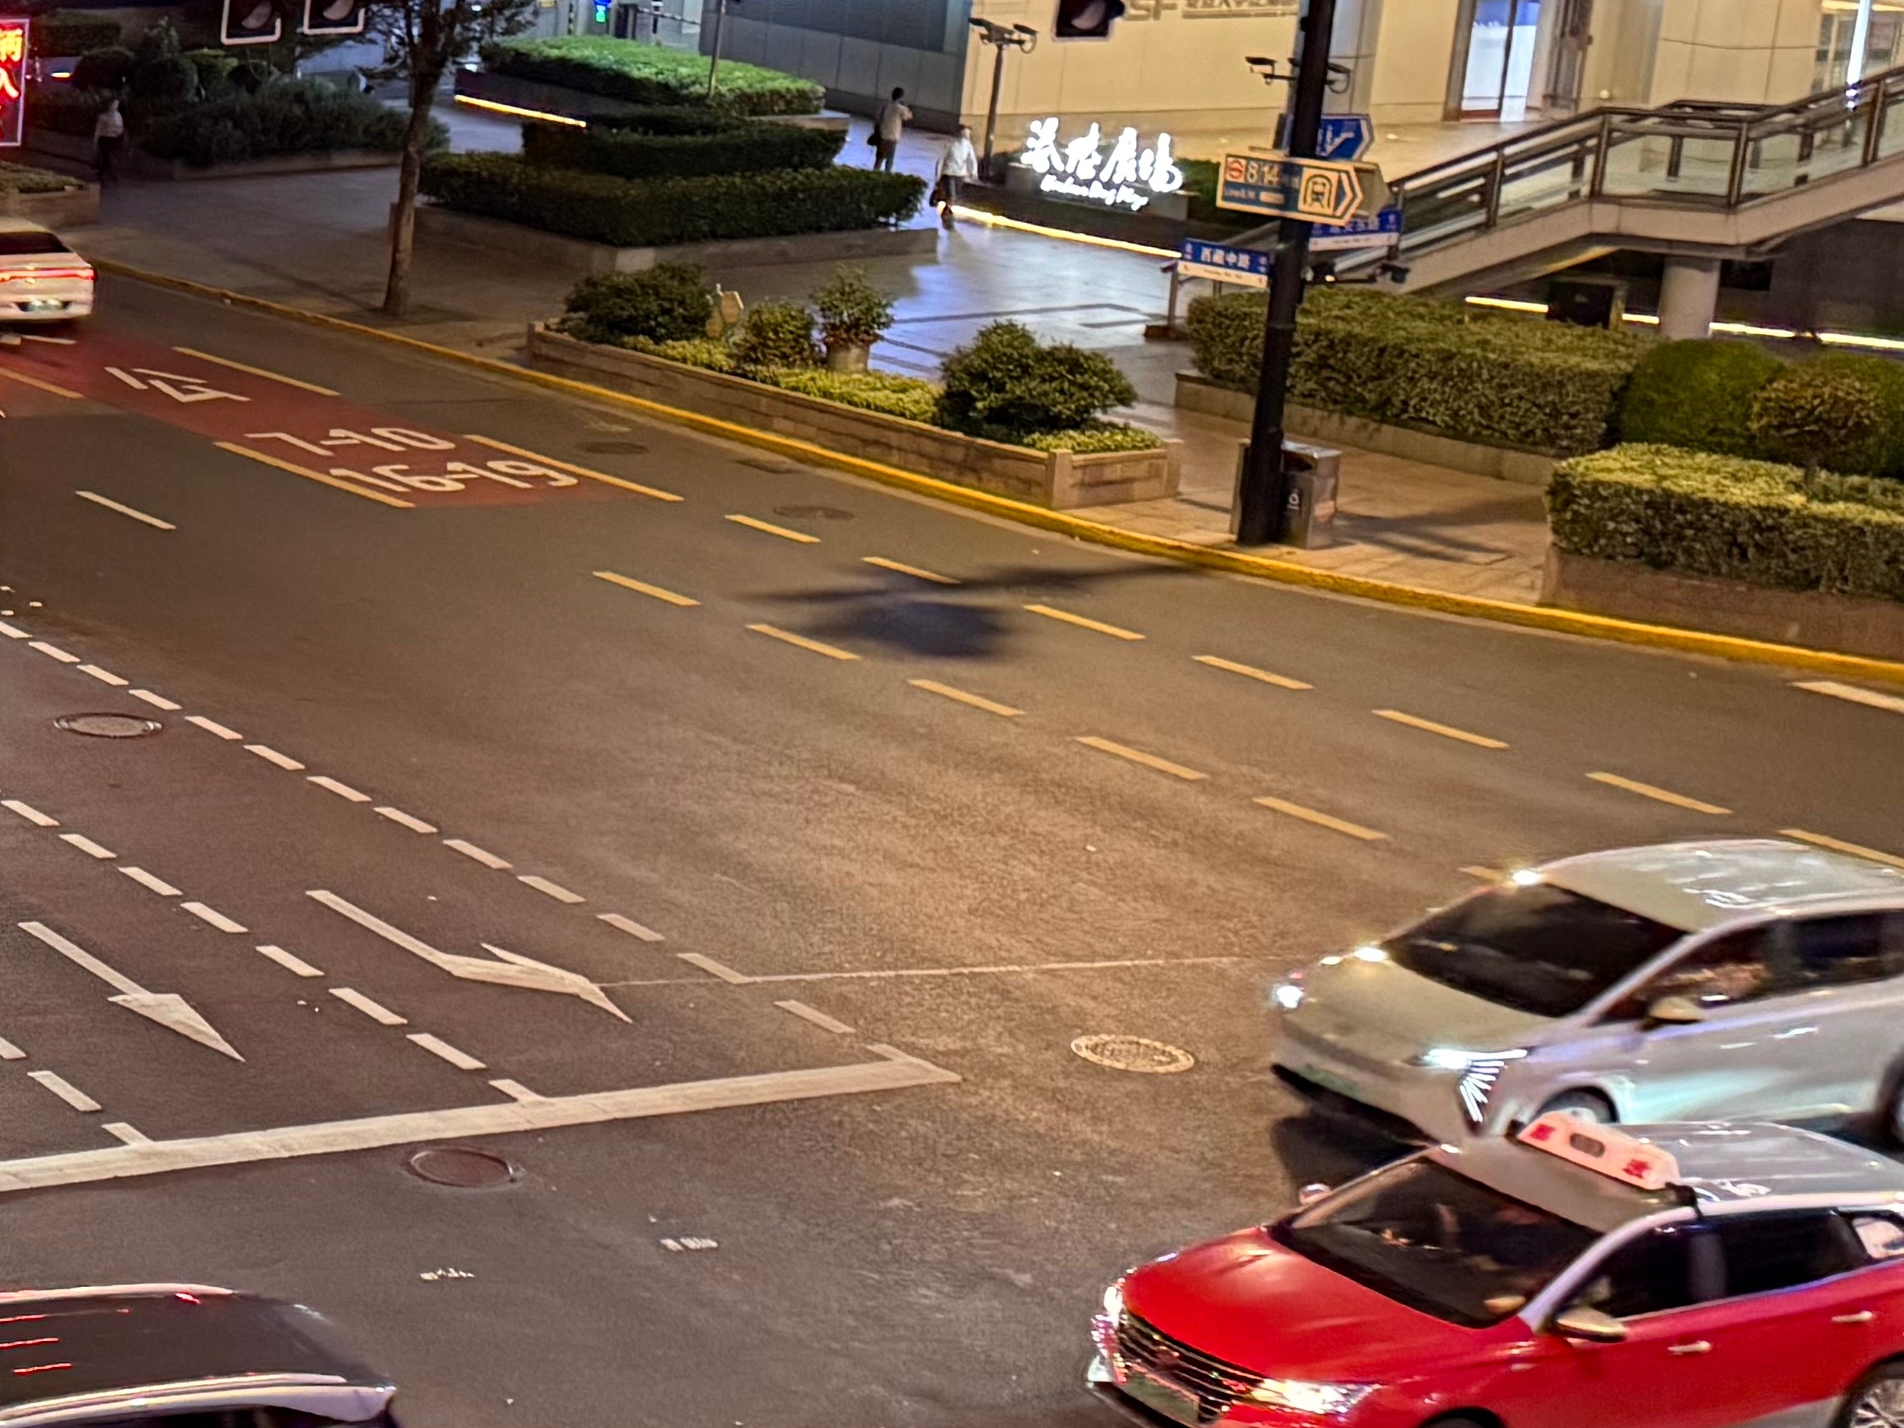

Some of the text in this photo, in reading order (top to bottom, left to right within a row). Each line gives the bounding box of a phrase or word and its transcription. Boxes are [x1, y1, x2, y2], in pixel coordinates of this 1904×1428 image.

[104, 366, 252, 403] 公
[243, 427, 457, 457] 7-10
[329, 459, 580, 492] 16-19
